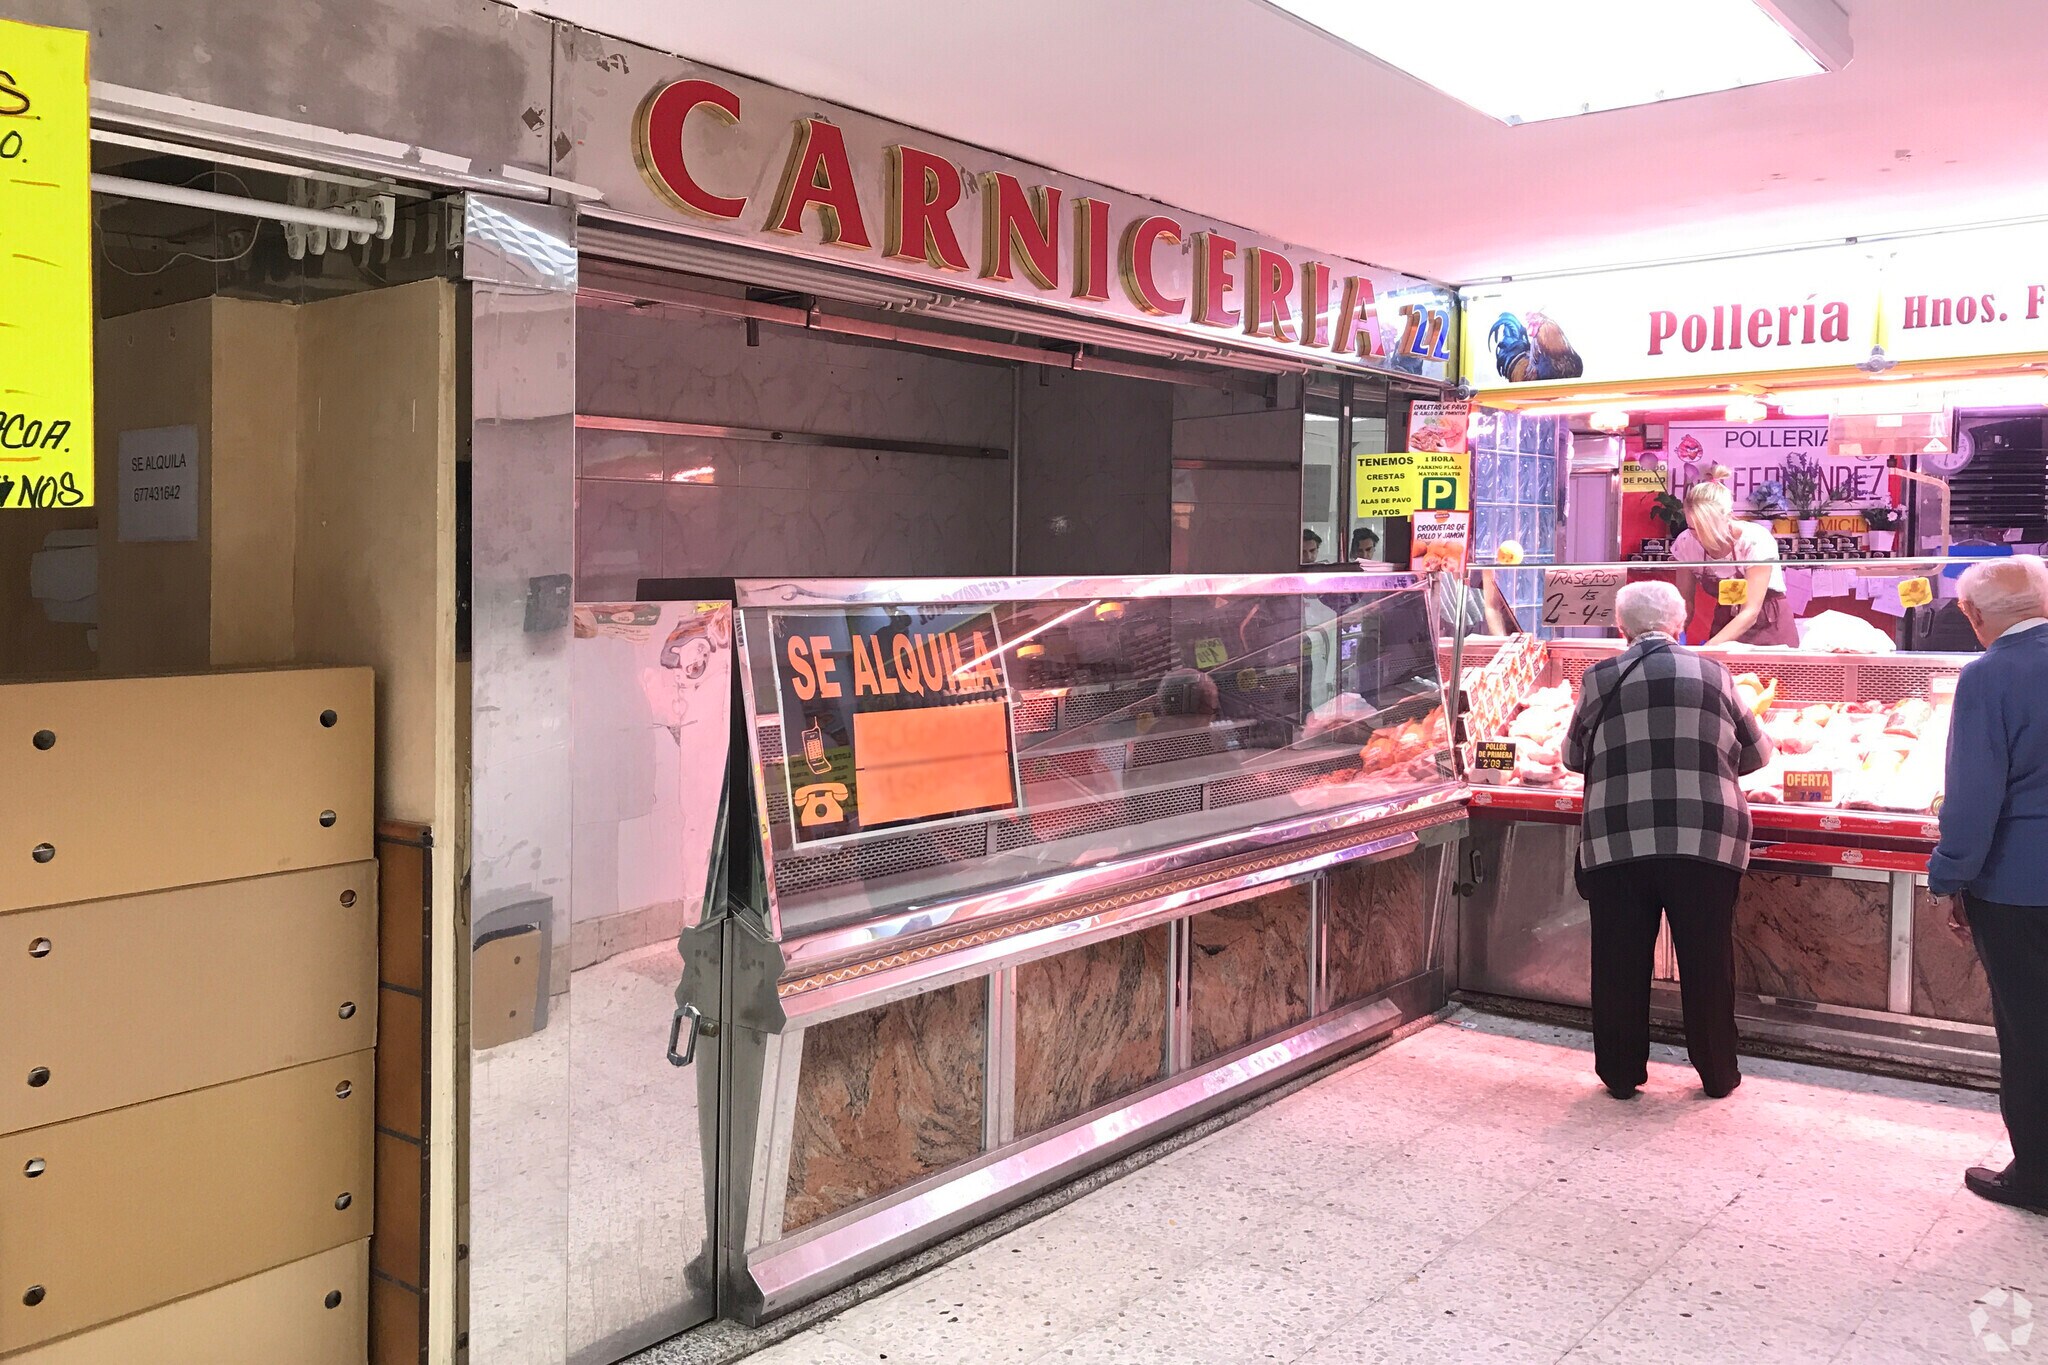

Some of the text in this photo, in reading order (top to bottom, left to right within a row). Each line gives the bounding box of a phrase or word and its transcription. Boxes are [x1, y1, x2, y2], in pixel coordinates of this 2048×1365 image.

[632, 78, 1386, 360] CARNICERIA
[1403, 303, 1450, 361] 22
[1647, 293, 1850, 356] Pollería
[1902, 293, 2008, 330] Hnos.
[131, 453, 187, 472] SE ALQUILA
[1357, 456, 1414, 466] TENEMOS
[134, 486, 181, 502] 677431642
[1417, 524, 1455, 532] CROQUETAS
[1549, 569, 1619, 587] TRASEROS
[788, 631, 999, 701] SE ALQUILA
[1786, 773, 1830, 786] OFERTA
